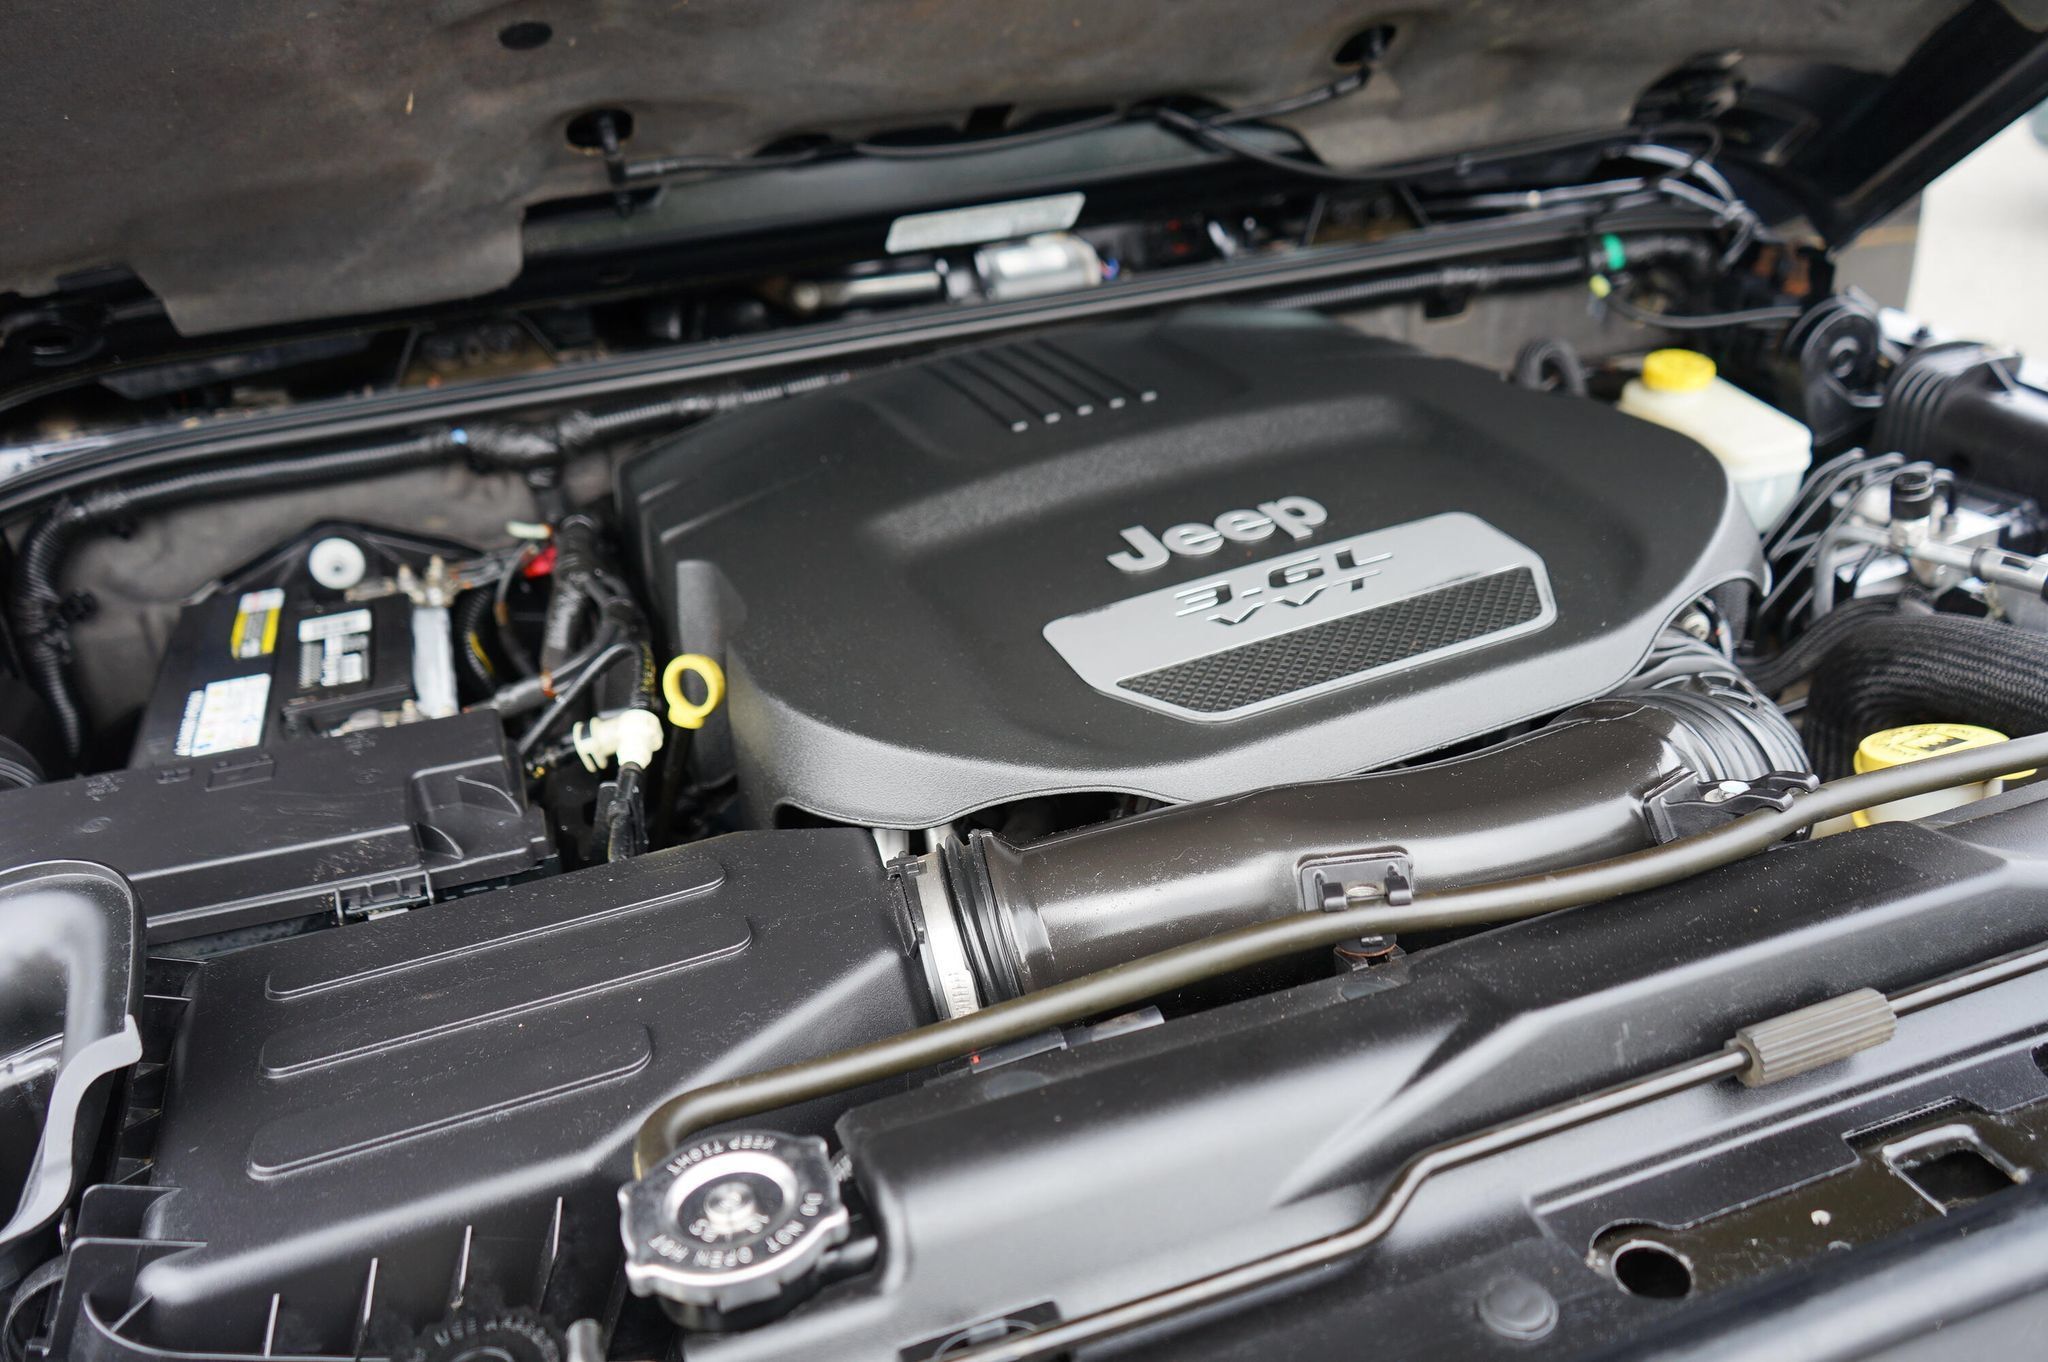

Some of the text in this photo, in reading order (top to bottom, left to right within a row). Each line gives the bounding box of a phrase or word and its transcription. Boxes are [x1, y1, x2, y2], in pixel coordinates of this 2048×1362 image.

[1106, 496, 1328, 574] Jeep
[1206, 569, 1382, 626] VVT
[666, 1135, 776, 1176] KEEP TIGHT
[800, 1192, 824, 1216] DO
[648, 1234, 689, 1262] HOT
[765, 1220, 805, 1253] NOT
[693, 1246, 753, 1268] OPEN
